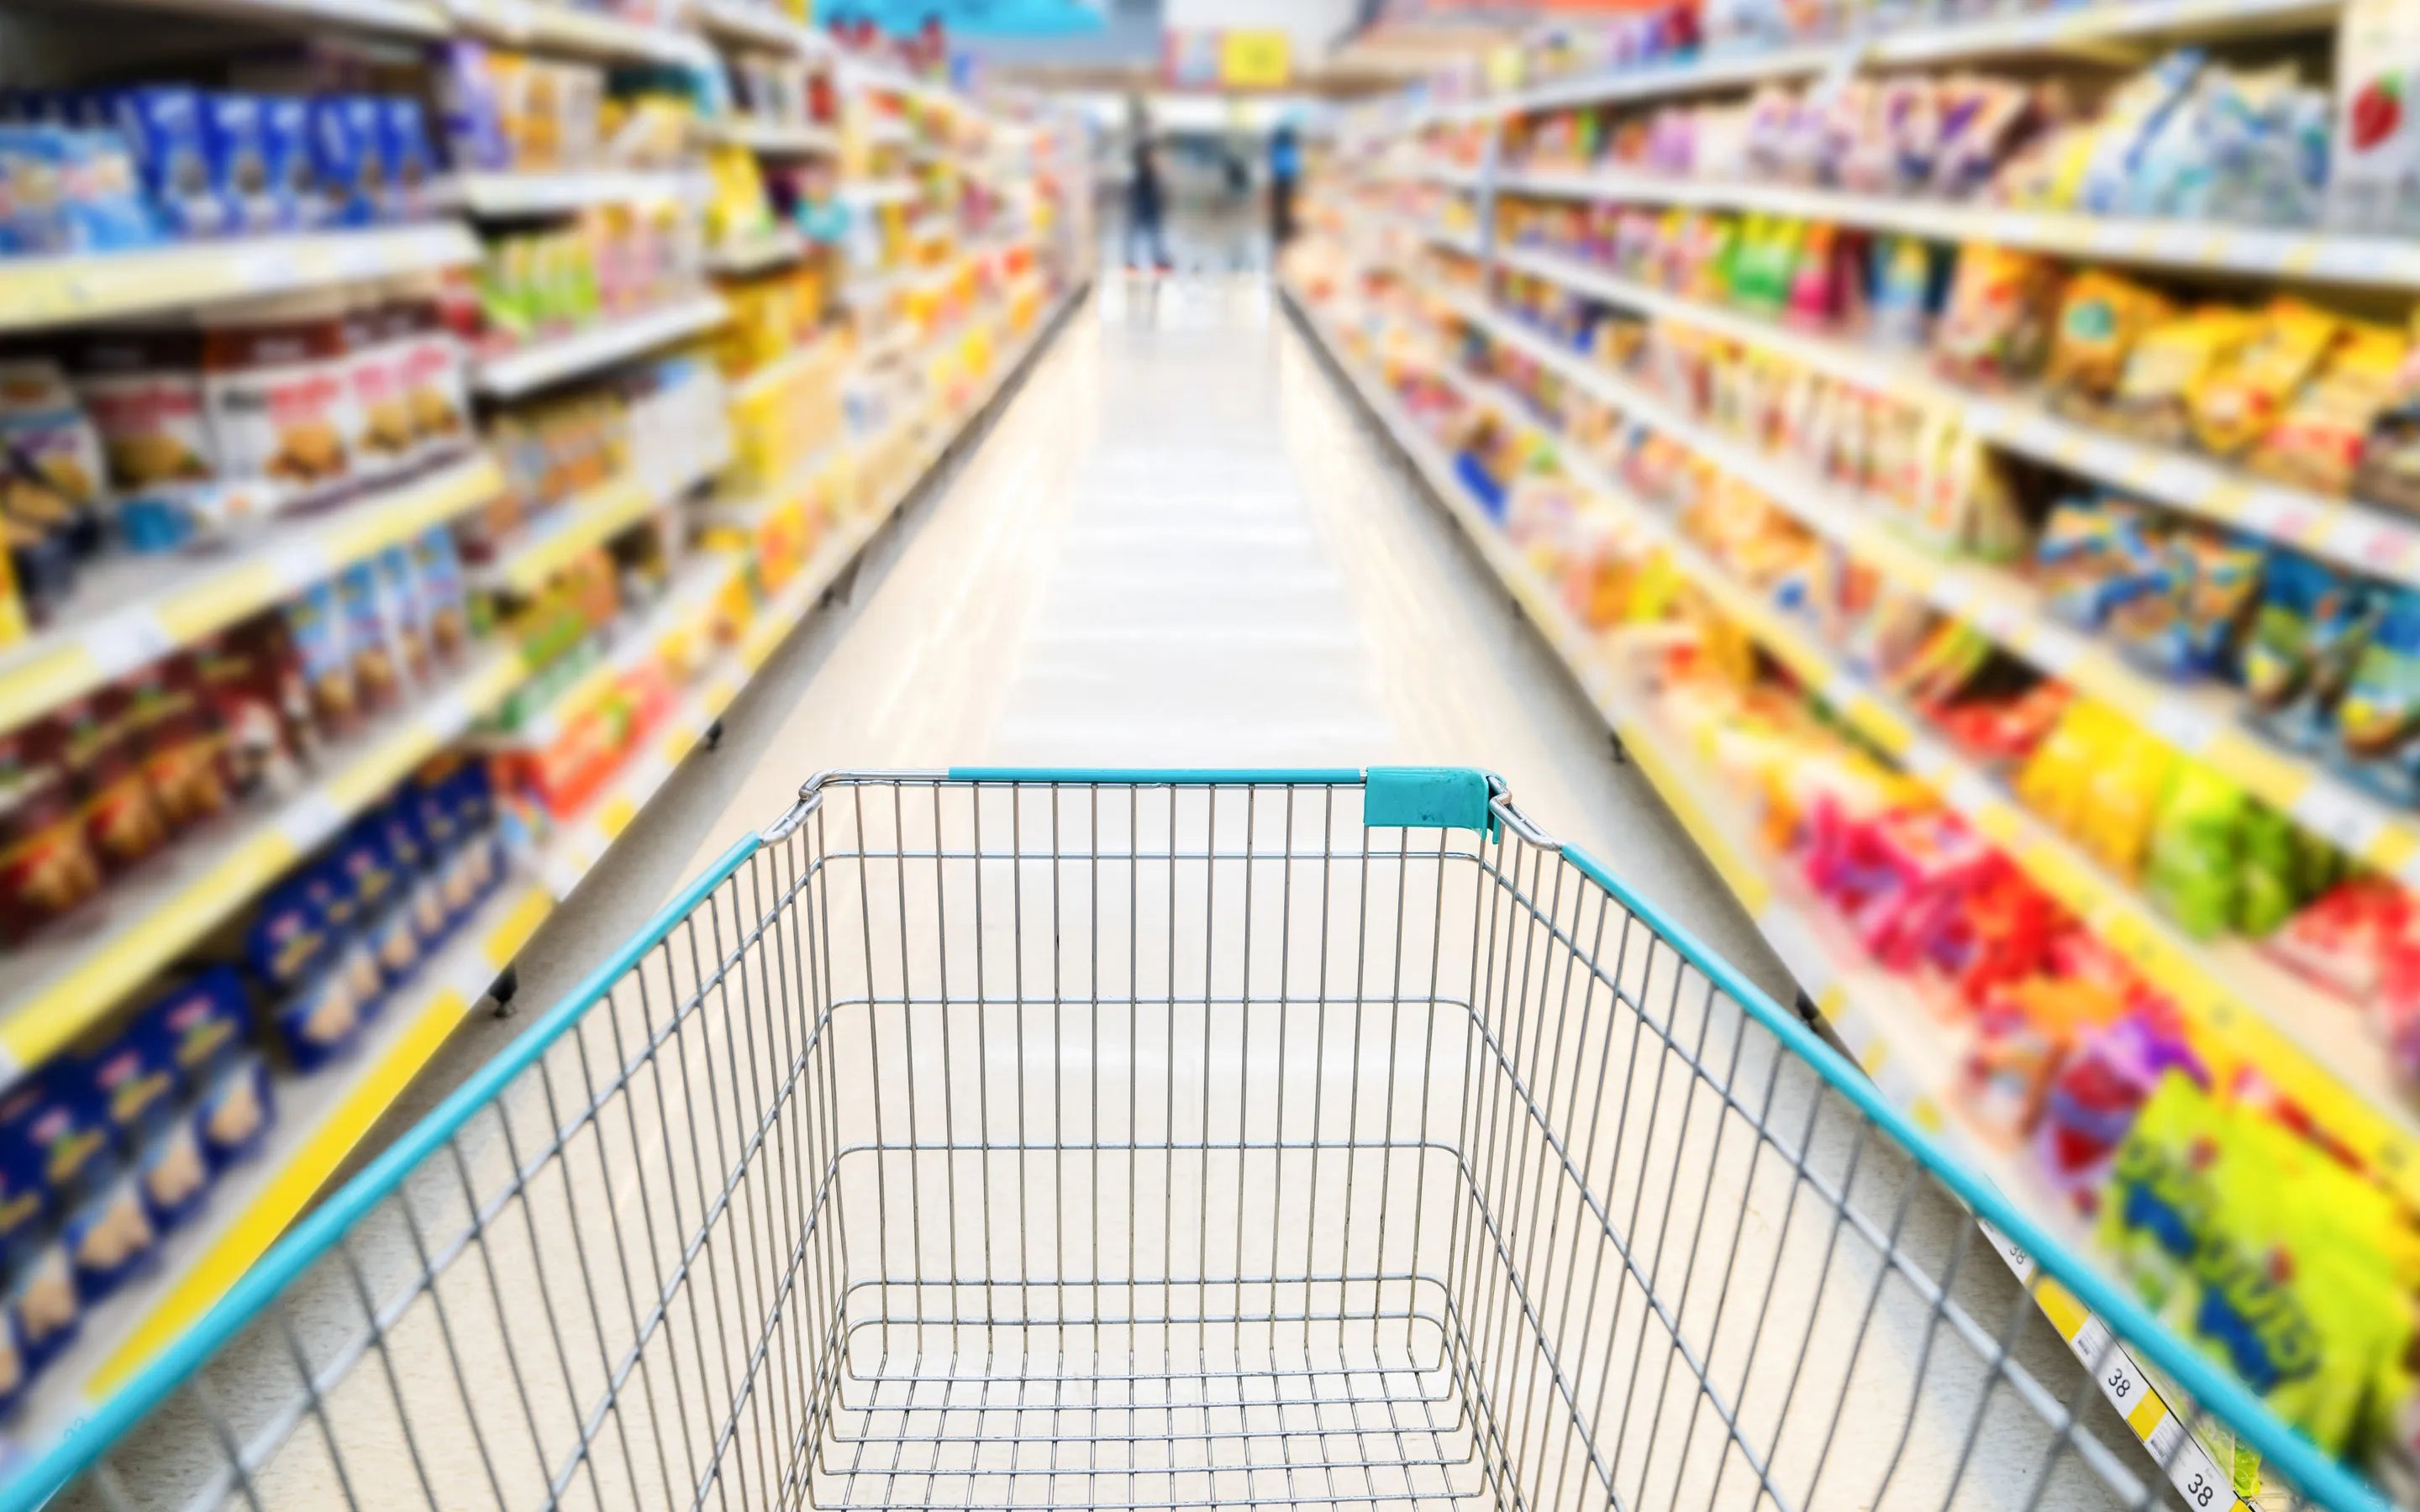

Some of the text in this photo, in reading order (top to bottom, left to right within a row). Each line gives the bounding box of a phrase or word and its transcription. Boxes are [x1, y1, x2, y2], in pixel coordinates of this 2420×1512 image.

[2009, 1246, 2028, 1265] 38
[2108, 1368, 2131, 1398] 38
[2187, 1473, 2213, 1508] 38
